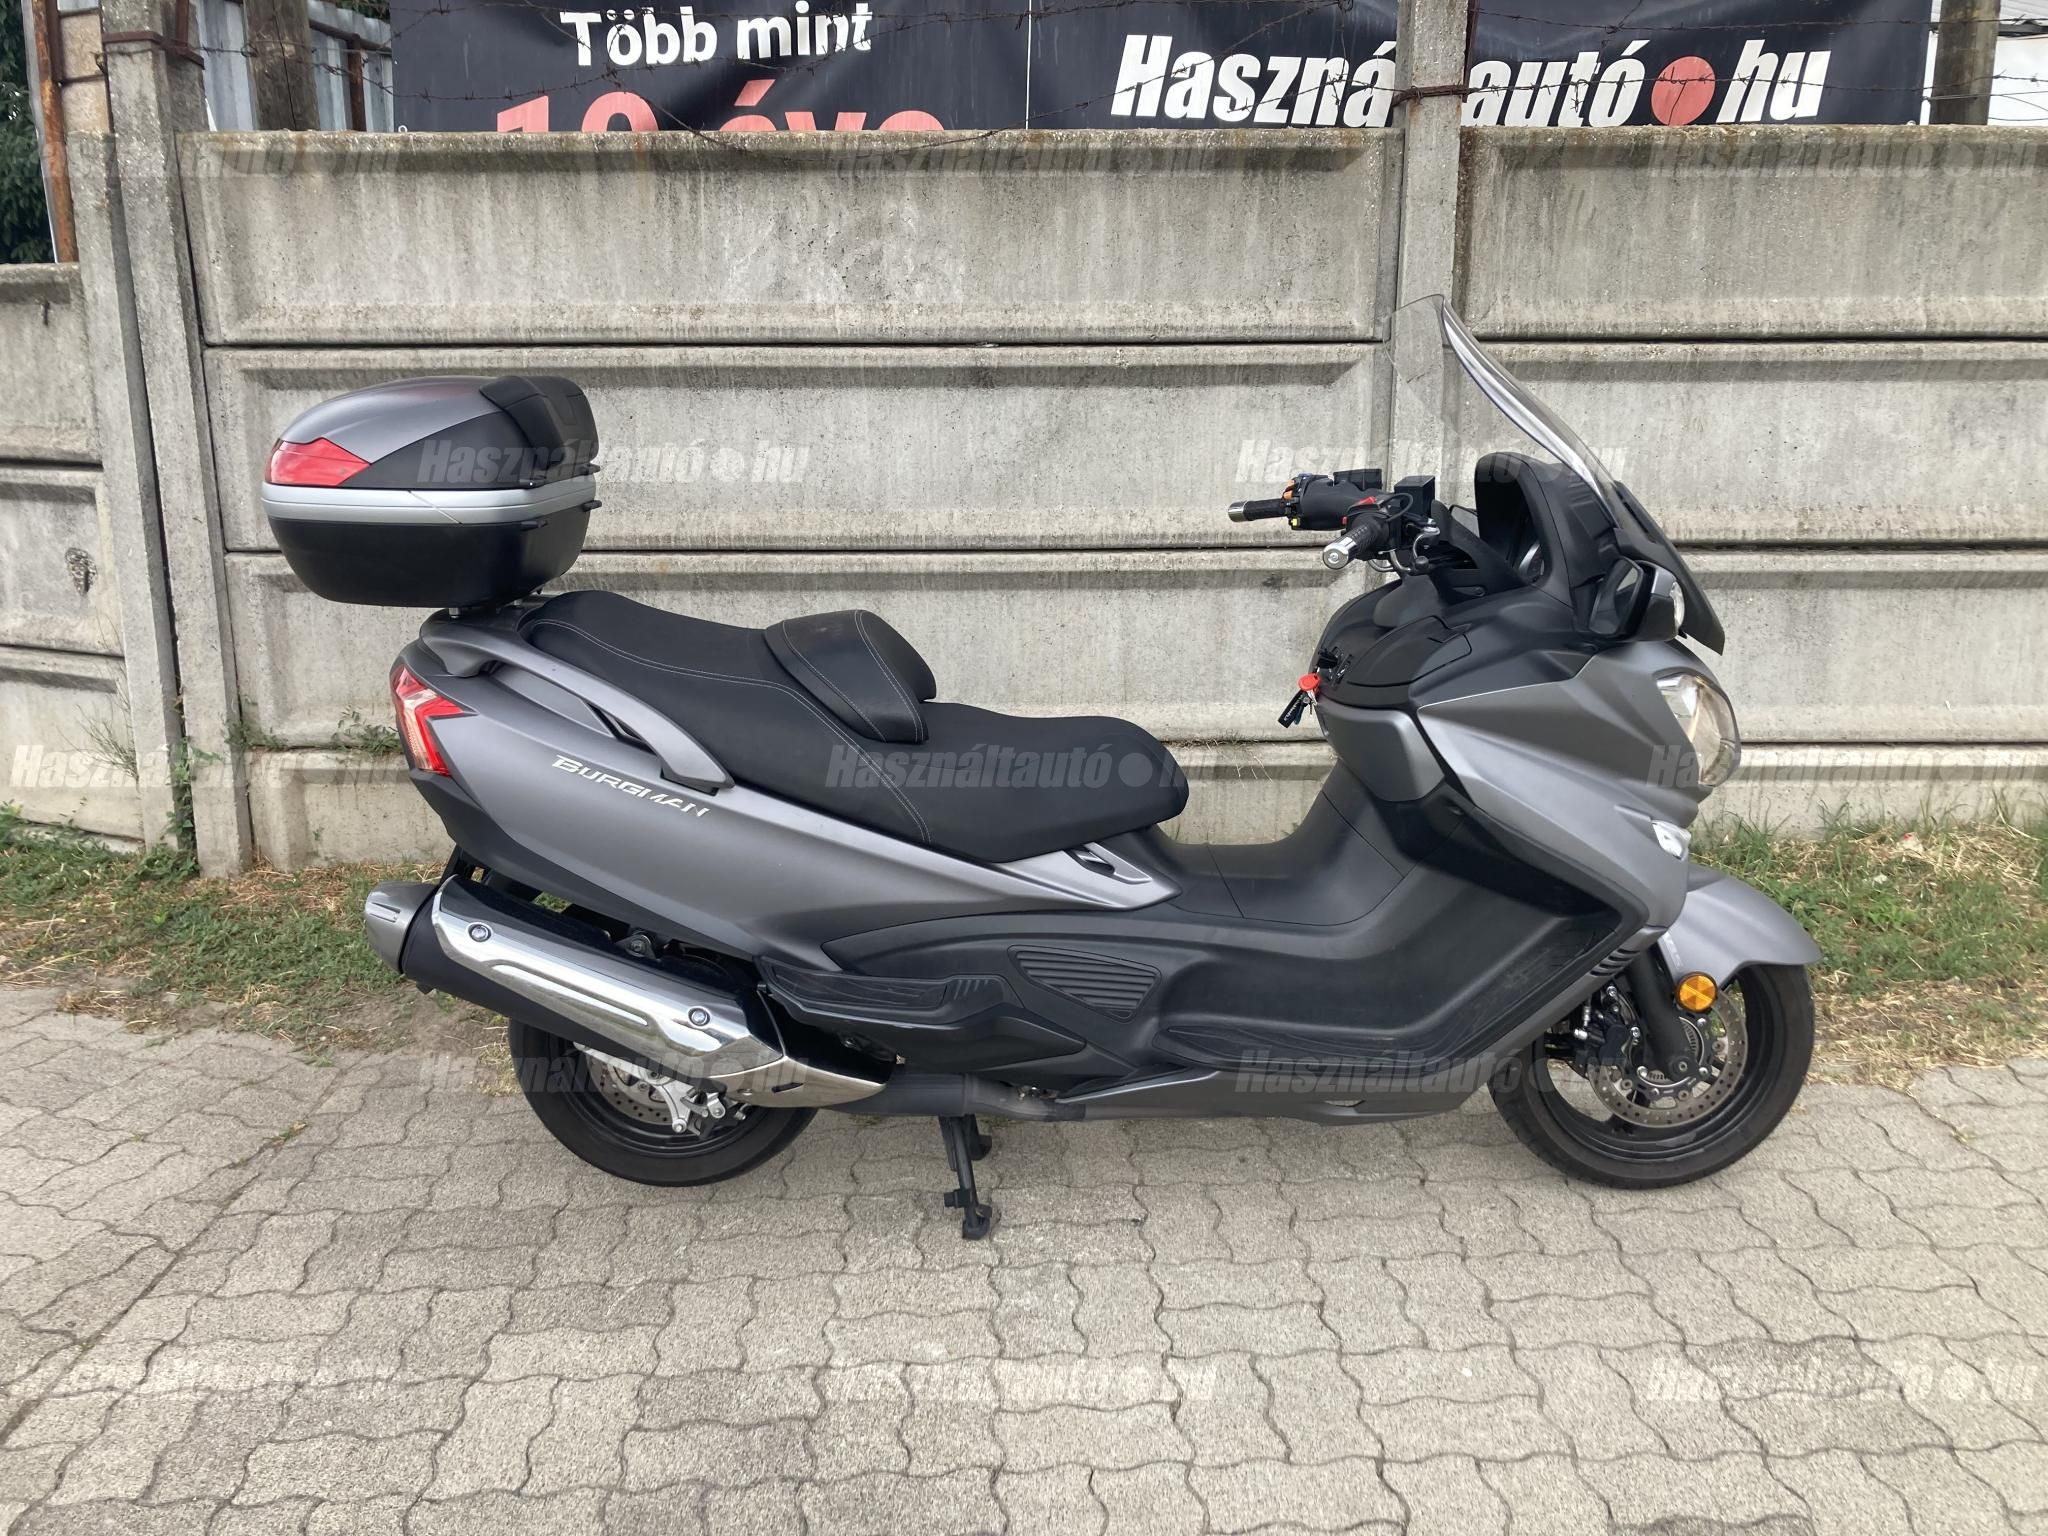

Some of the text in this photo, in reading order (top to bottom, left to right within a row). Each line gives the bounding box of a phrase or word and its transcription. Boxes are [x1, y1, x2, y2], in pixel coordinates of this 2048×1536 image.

[560, 1, 873, 66] Több mint
[552, 754, 710, 817] BURGMAN
